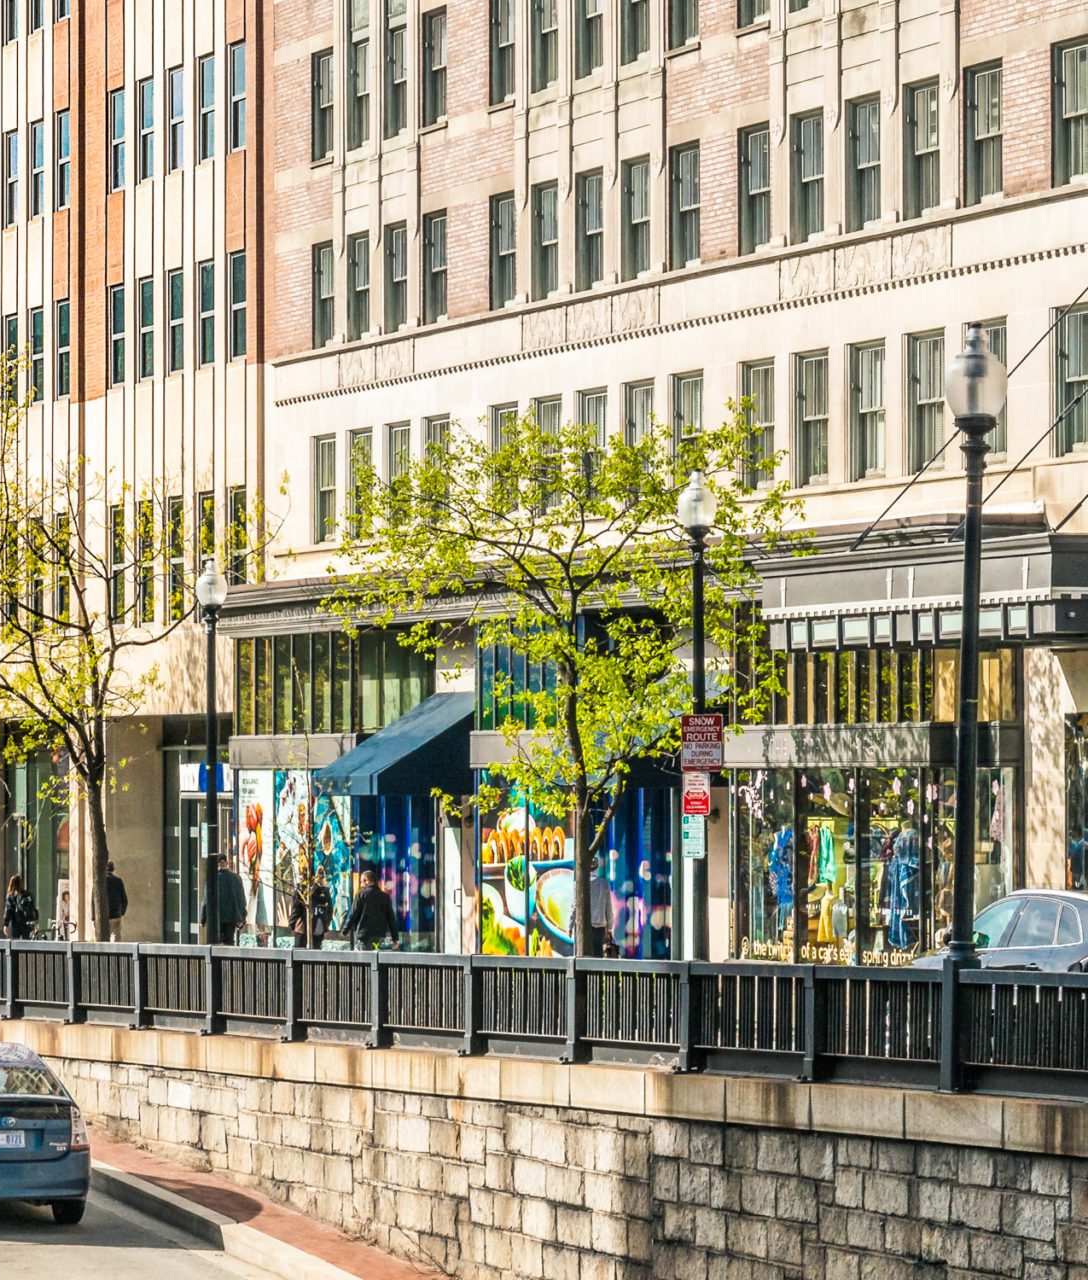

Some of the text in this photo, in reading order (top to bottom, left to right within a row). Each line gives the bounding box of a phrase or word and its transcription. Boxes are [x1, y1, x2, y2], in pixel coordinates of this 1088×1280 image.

[689, 717, 715, 726] SNOW
[686, 733, 717, 741] ROUTE
[753, 939, 767, 956] the
[801, 942, 810, 958] of
[811, 948, 816, 958] a
[862, 949, 888, 967] spring
